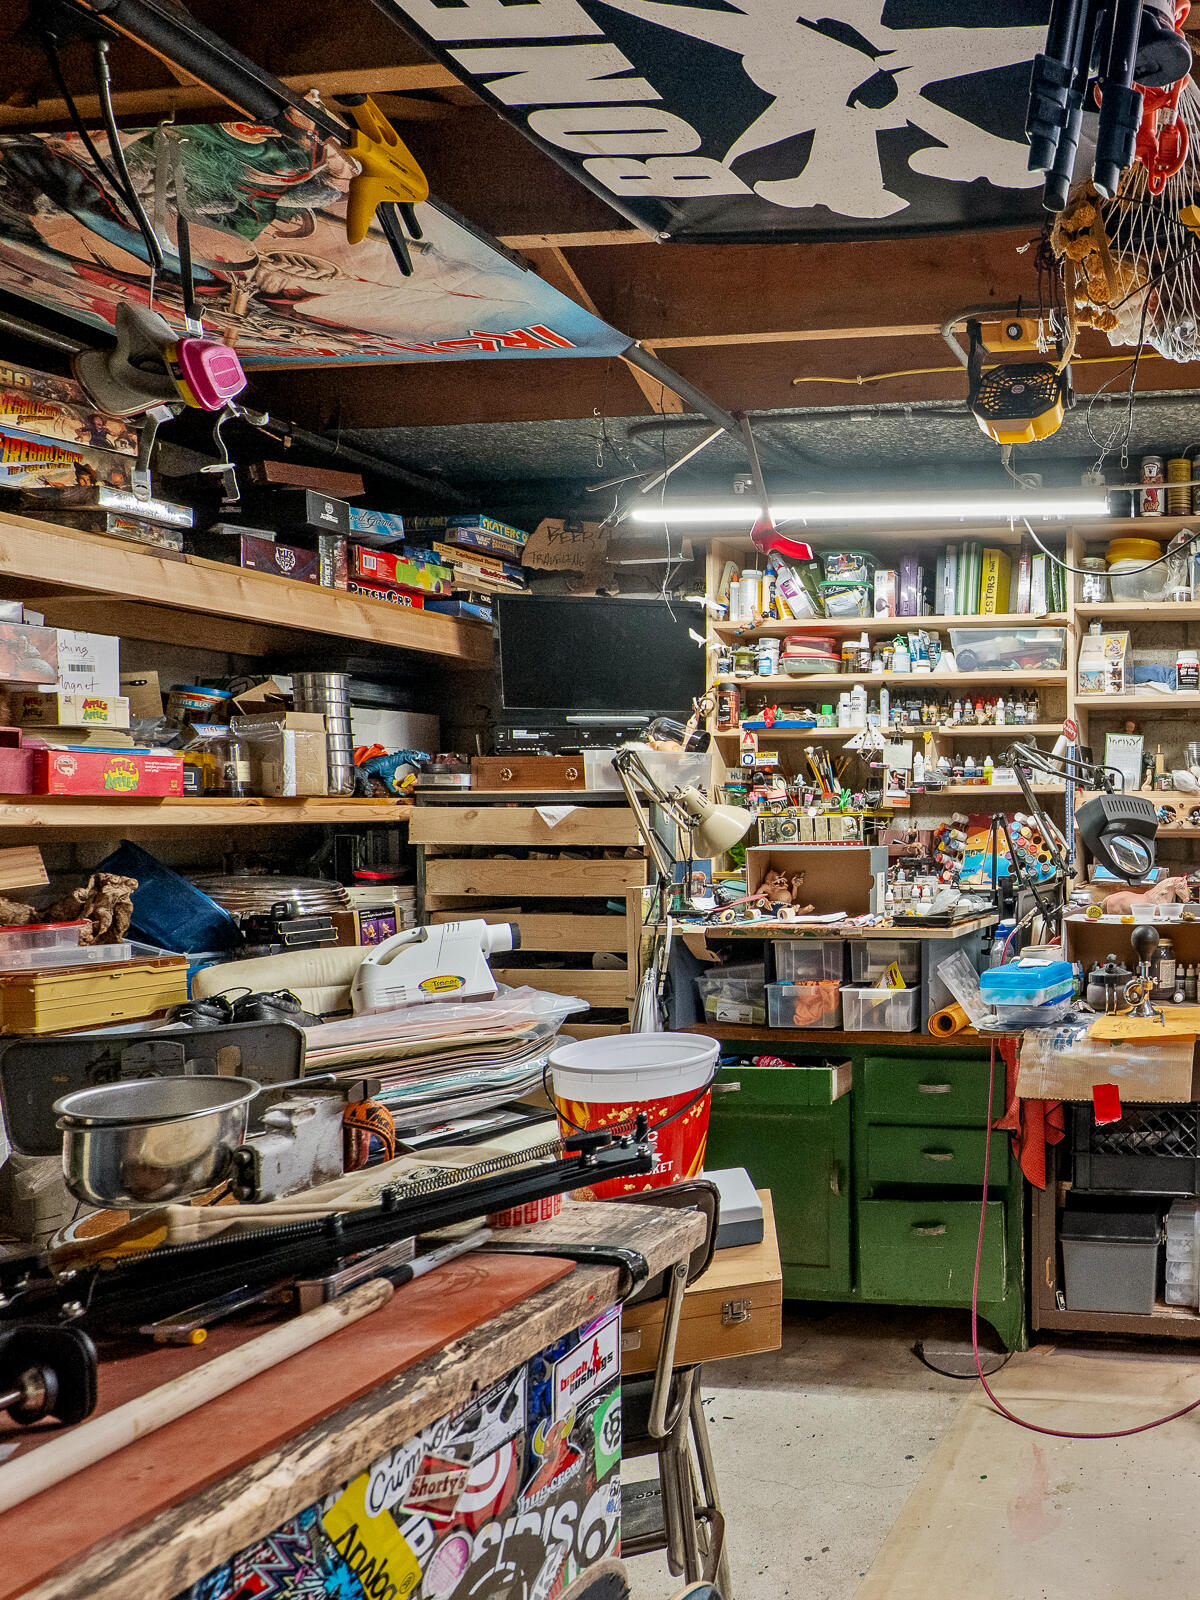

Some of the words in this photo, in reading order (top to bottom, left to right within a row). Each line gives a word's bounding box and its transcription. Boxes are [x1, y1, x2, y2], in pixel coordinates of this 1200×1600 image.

[482, 518, 522, 541] SKATERS
[983, 575, 996, 616] ESTORS
[82, 698, 109, 710] APPLES
[82, 707, 109, 721] APPLES
[105, 774, 138, 791] APPLES
[409, 1470, 470, 1498] Shorty's
